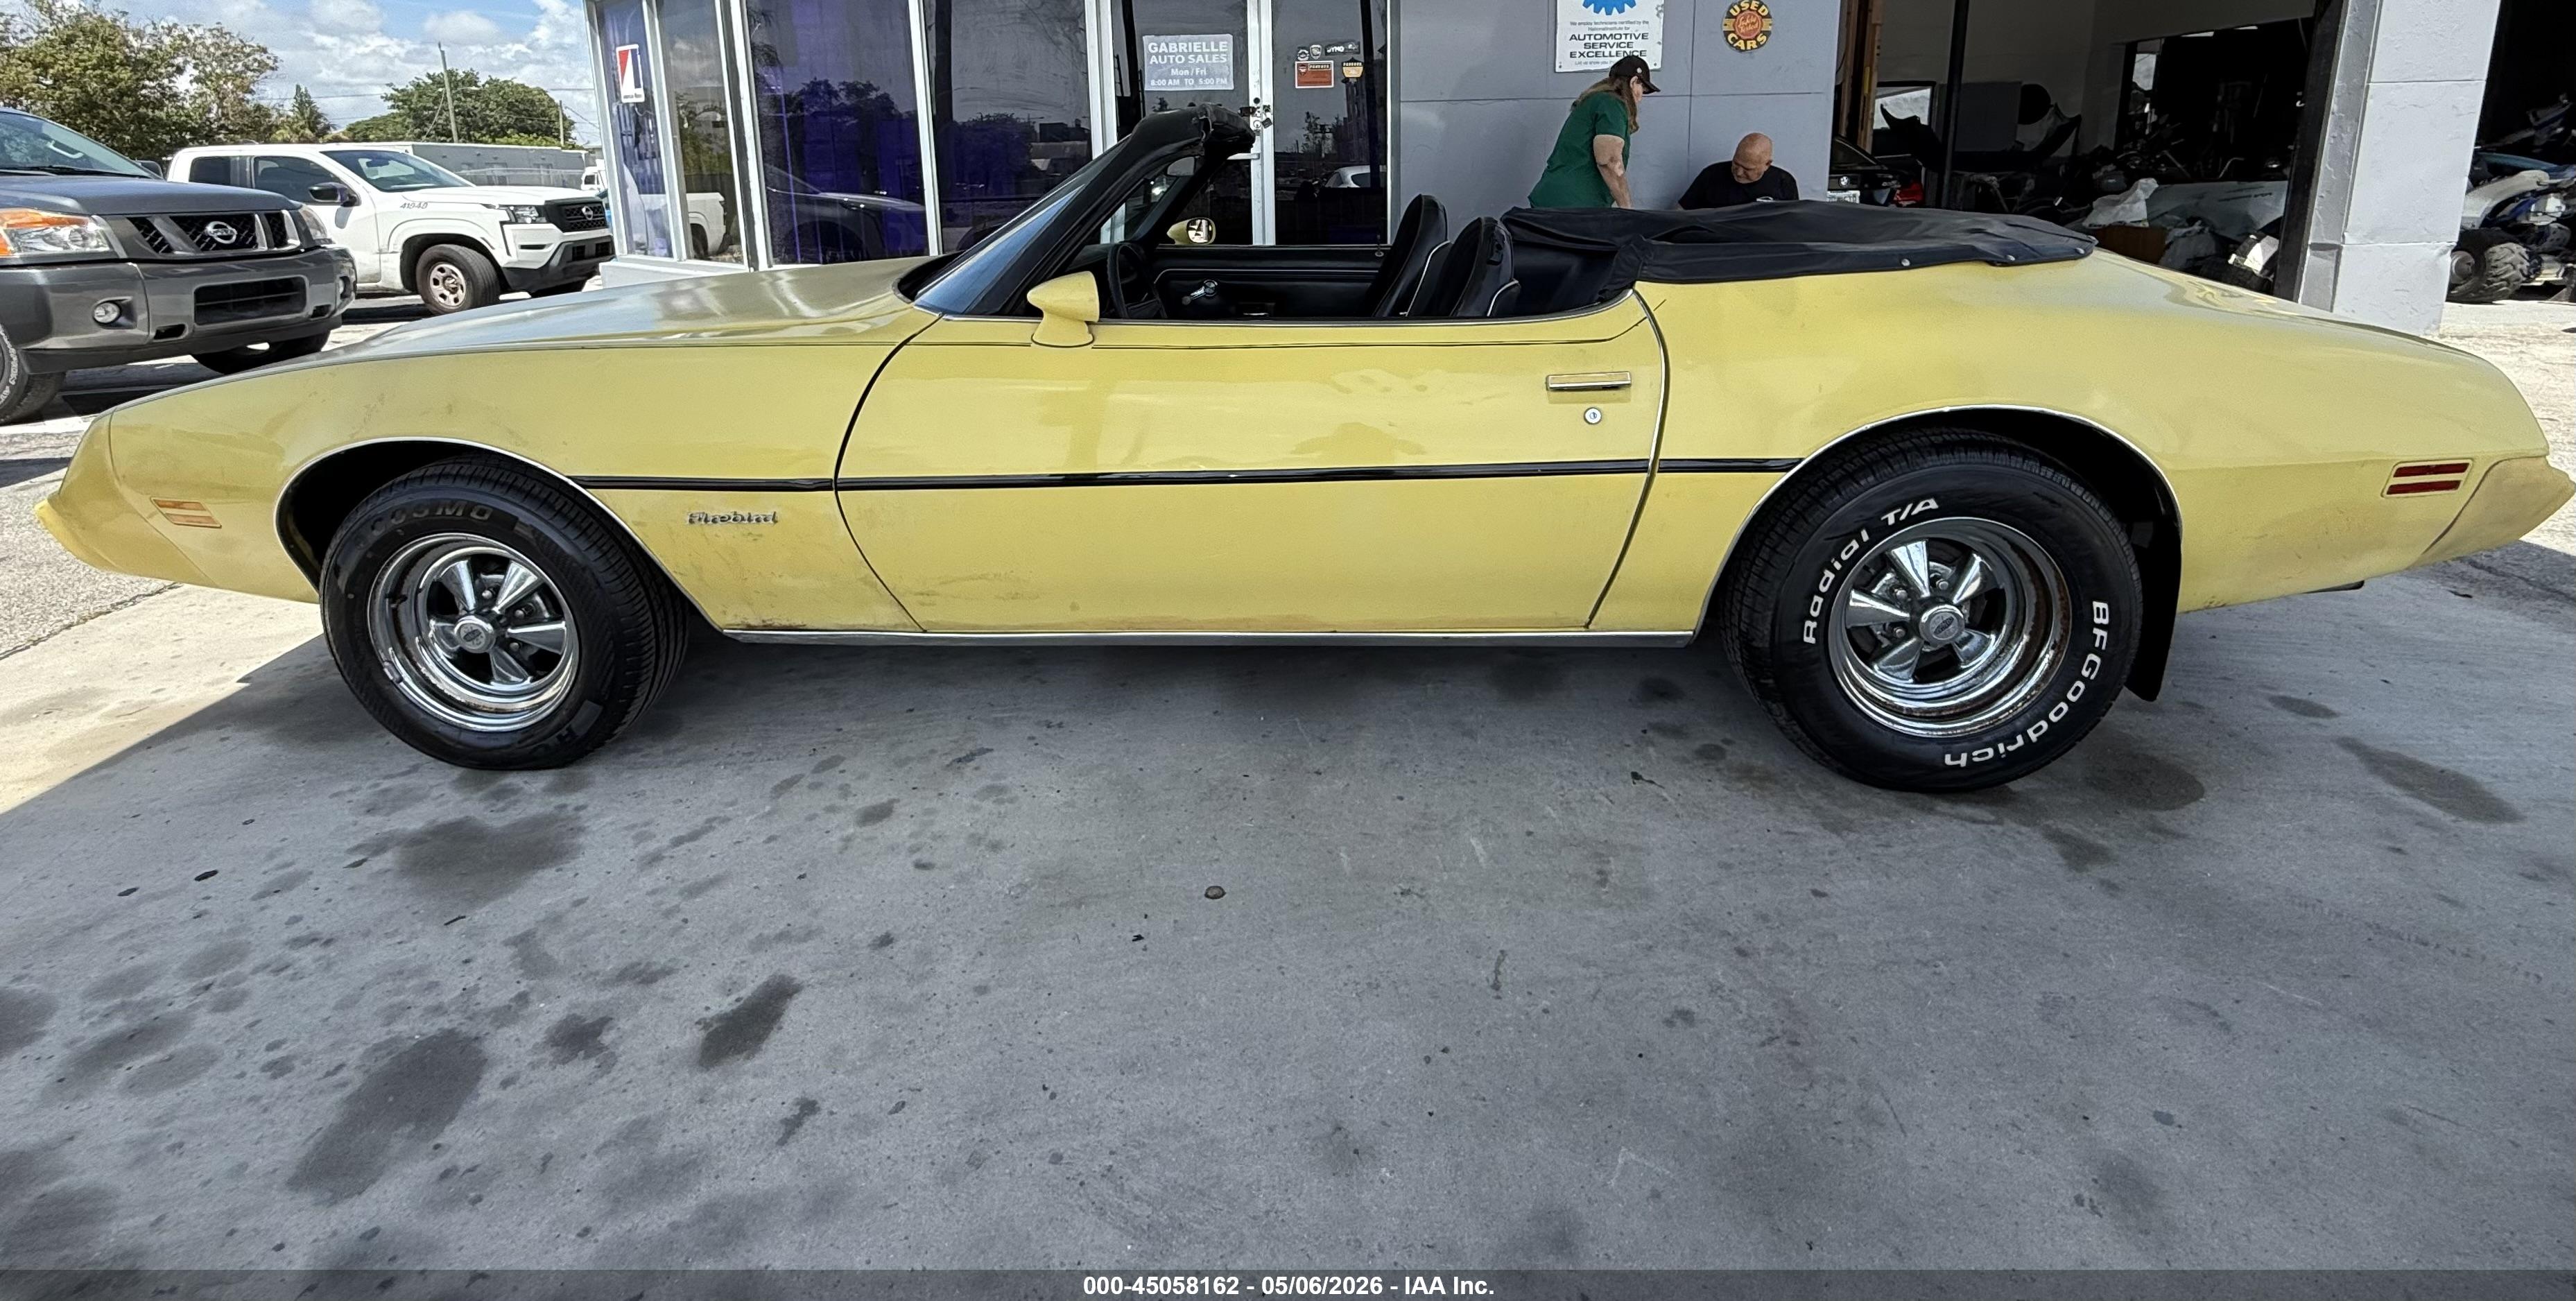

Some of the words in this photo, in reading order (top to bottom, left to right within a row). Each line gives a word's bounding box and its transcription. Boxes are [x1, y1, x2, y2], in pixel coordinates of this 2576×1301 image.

[1729, 0, 1768, 16] USED
[1569, 33, 1649, 41] AUTOMOTIVE
[1727, 33, 1767, 50] CARS
[1148, 42, 1228, 53] GABRIELLE
[1570, 50, 1648, 58] EXCELLENCE
[1150, 55, 1185, 64] AUTO
[1188, 54, 1227, 63] SALES
[1195, 67, 1207, 76] Fri
[688, 510, 779, 525] Firebird
[1803, 529, 1870, 644] Radial
[1881, 497, 1939, 526] T/A
[1944, 600, 2109, 767] BFGoodrich
